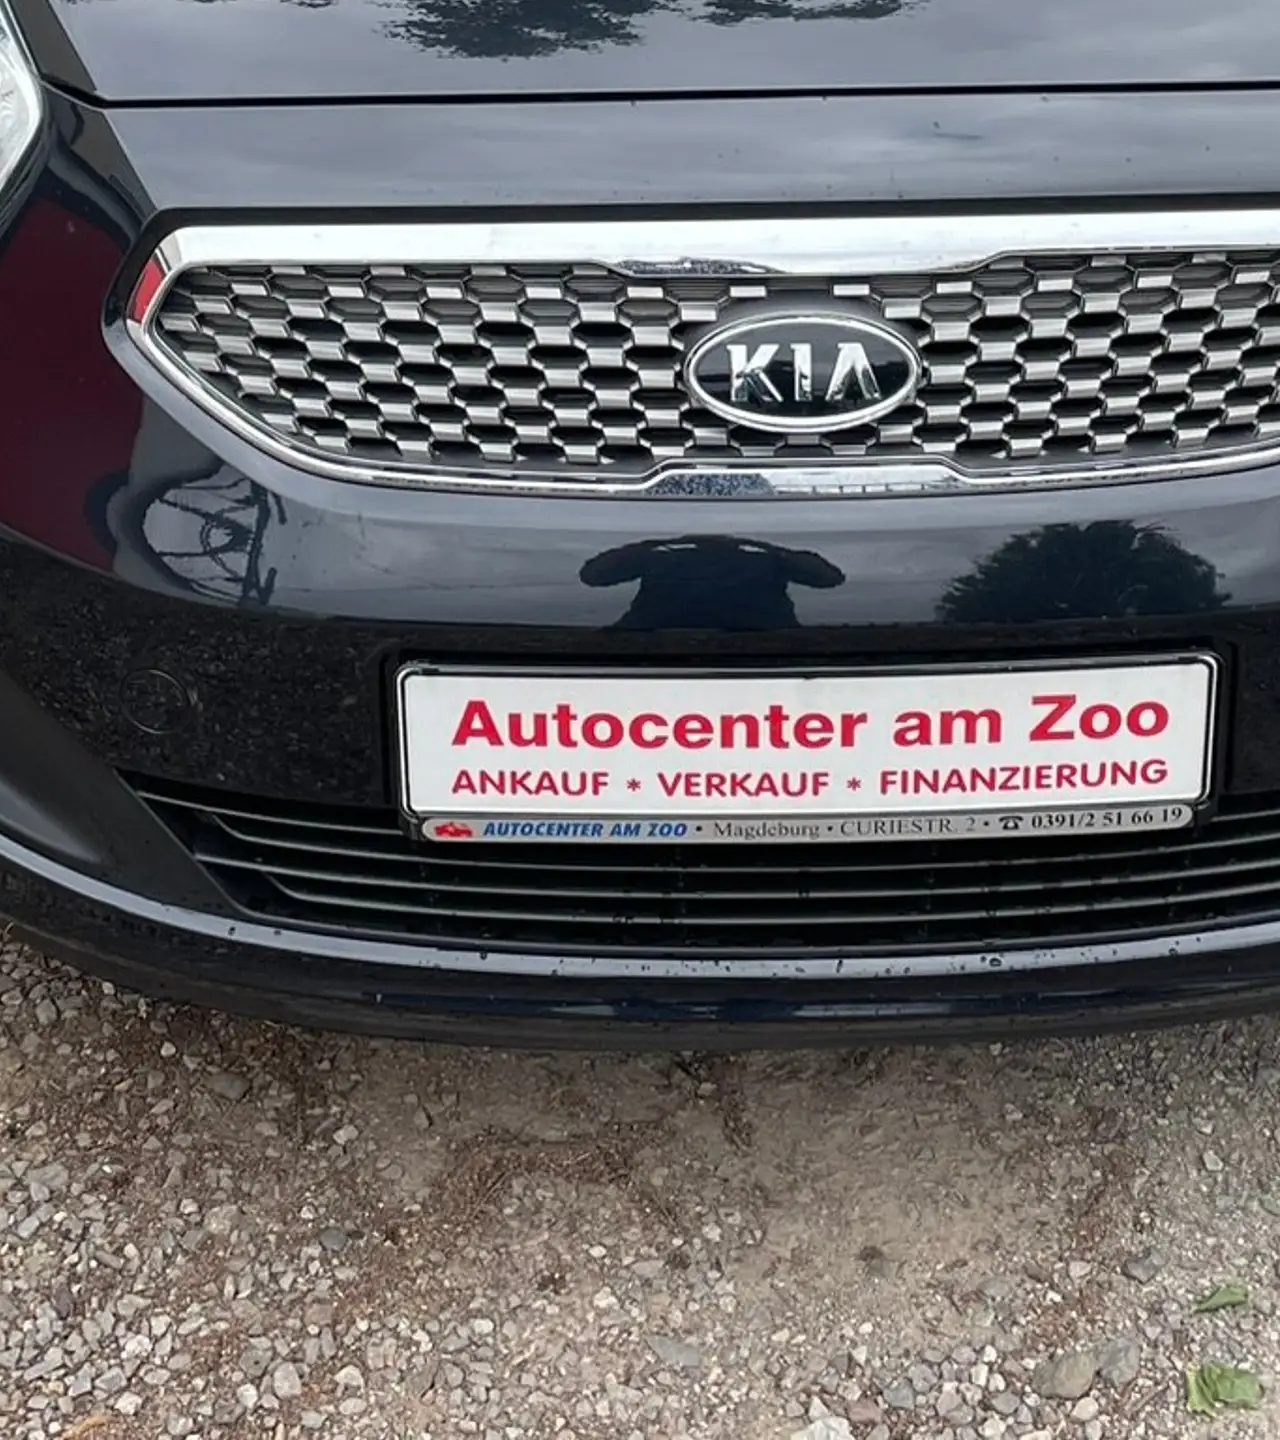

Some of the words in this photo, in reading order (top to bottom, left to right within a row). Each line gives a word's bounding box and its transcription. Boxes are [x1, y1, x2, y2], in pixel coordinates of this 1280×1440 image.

[726, 342, 881, 403] KIA
[453, 699, 867, 750] Autocenter
[894, 708, 1002, 748] am
[1029, 694, 1170, 742] Zoo
[452, 769, 608, 796] ANKAUF
[658, 771, 829, 796] VERKAUF
[880, 759, 1167, 796] FINANZIERUNG
[482, 820, 604, 839] AUTOCENTER
[608, 822, 641, 838] AM
[646, 822, 689, 838] ZOO
[713, 820, 821, 840] Magdeburg
[965, 816, 976, 832] 2
[1031, 812, 1096, 830] 0391/2
[1102, 810, 1123, 827] 51
[1130, 809, 1154, 825] 66
[1161, 807, 1184, 823] 19
